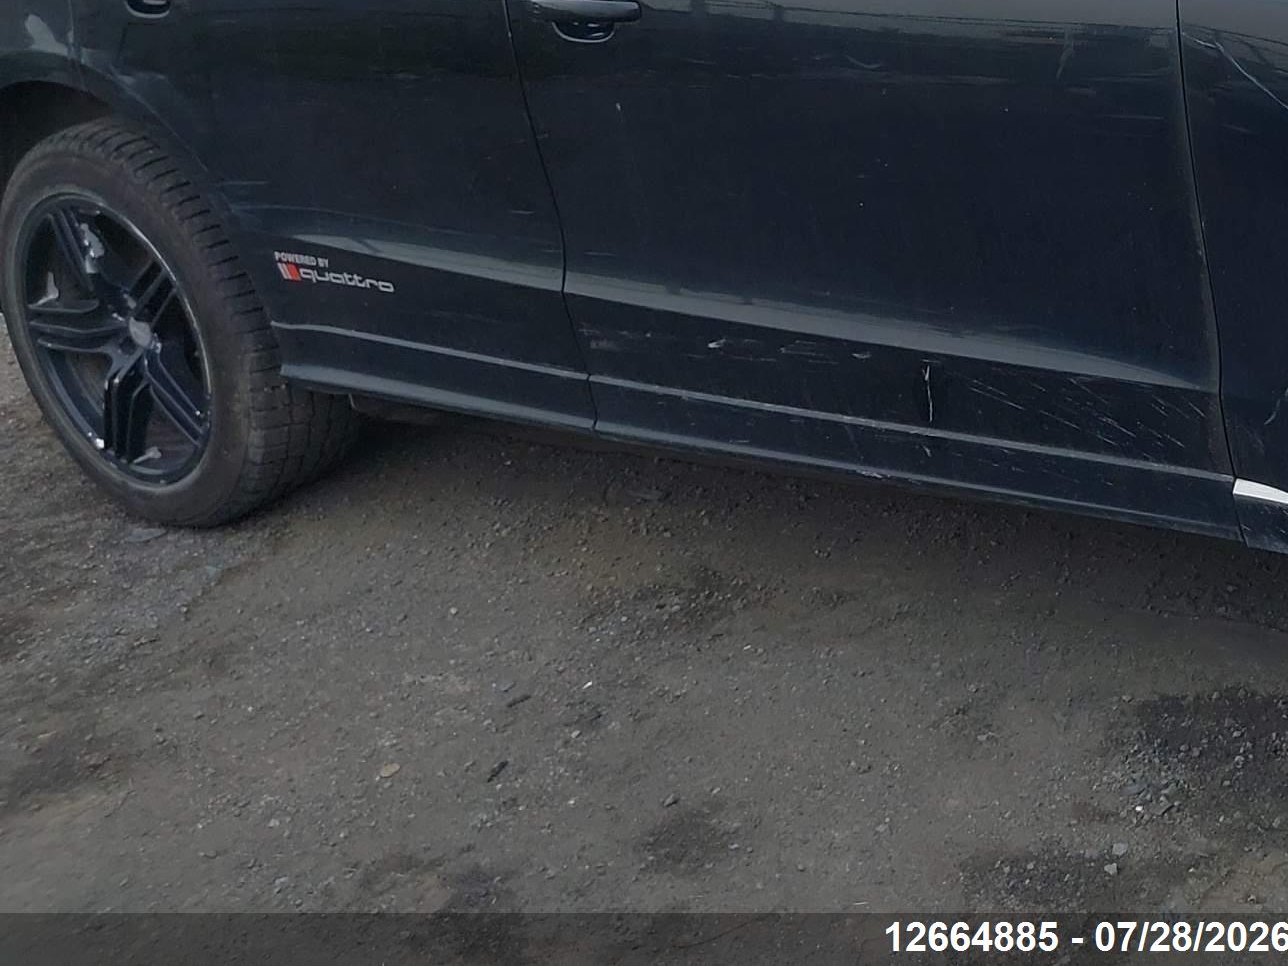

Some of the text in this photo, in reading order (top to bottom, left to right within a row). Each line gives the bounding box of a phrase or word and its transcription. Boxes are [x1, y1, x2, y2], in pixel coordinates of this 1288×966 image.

[274, 251, 329, 268] POWERED BY
[300, 268, 395, 293] quattro
